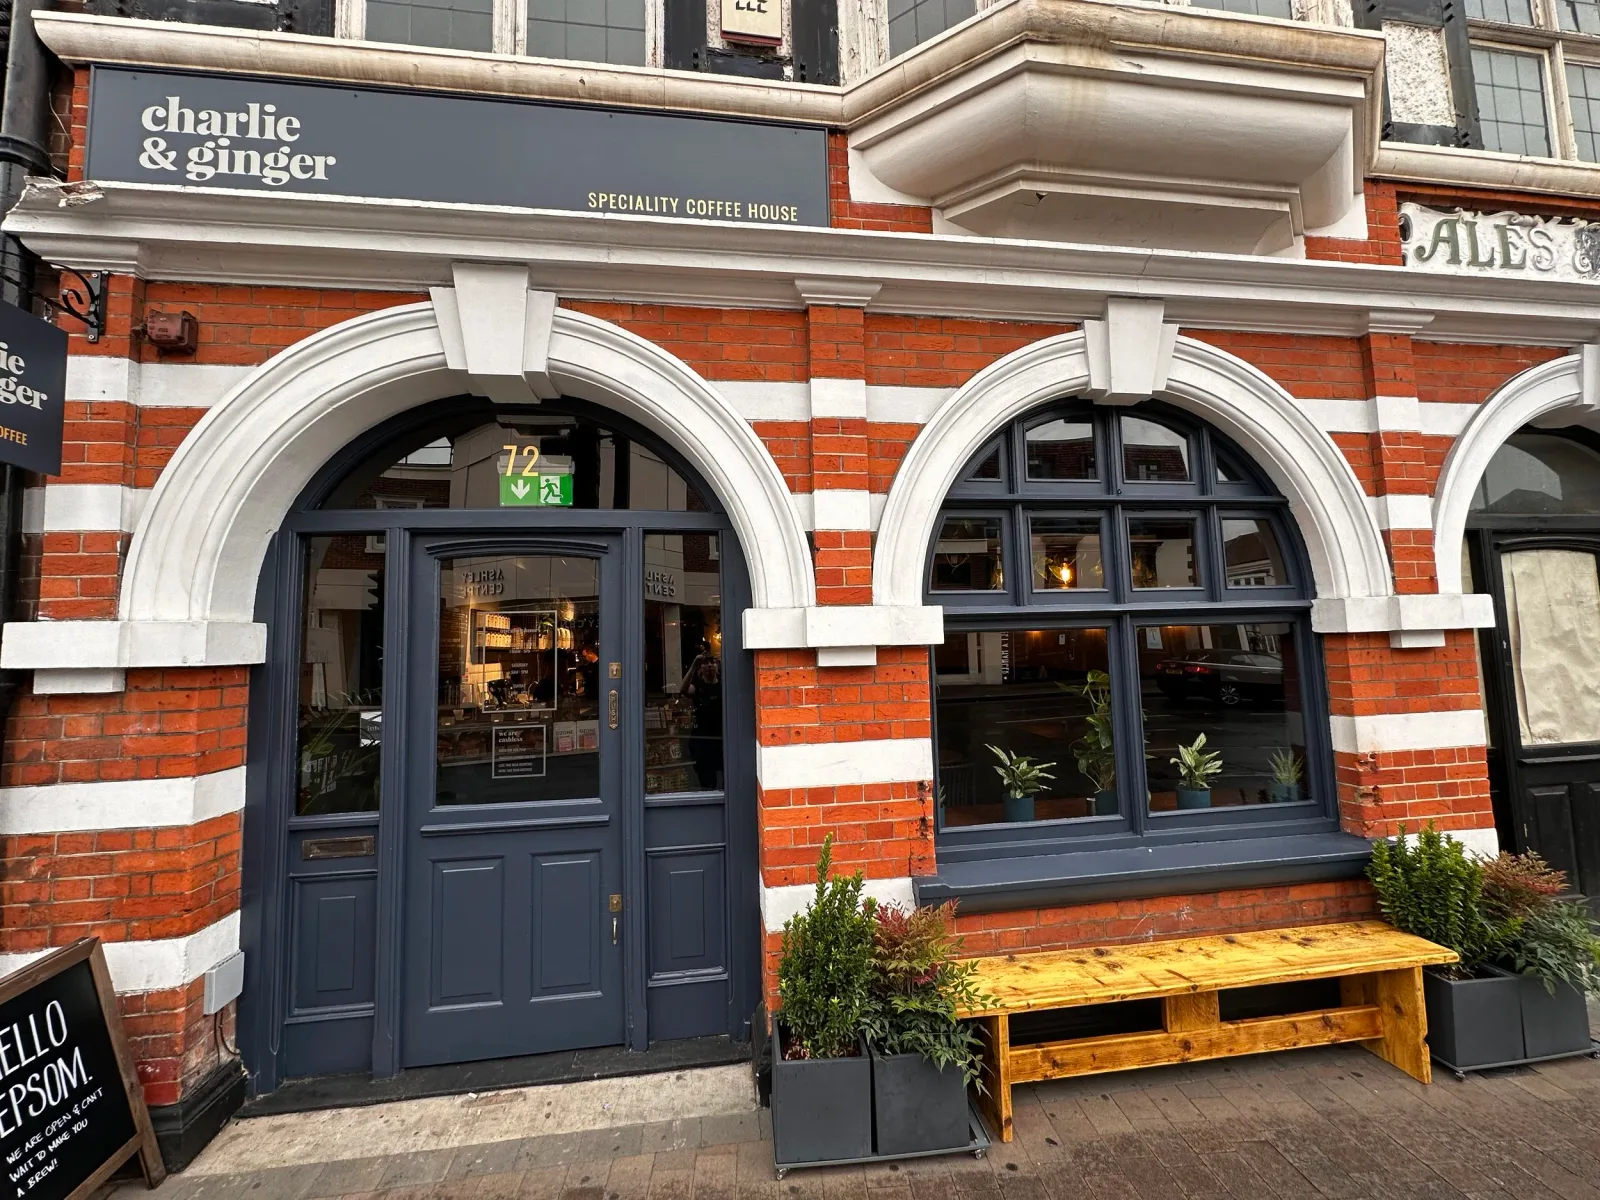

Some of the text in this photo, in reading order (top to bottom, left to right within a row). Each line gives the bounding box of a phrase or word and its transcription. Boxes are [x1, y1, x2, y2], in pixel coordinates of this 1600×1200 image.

[141, 96, 301, 142] charlie
[138, 136, 337, 186] & ginger
[588, 192, 798, 222] SPECIALITY COFFEE HOUSE
[1413, 218, 1556, 272] ALES
[503, 445, 539, 477] 72
[0, 999, 67, 1081] ELLO
[0, 1046, 93, 1138] EPSOM.
[6, 1147, 22, 1164] WE
[24, 1132, 43, 1152] ARE
[45, 1112, 72, 1136] OPEN
[72, 1103, 80, 1115] &
[8, 1118, 88, 1182] WAIT TO MAKE YOU
[16, 1158, 59, 1198] A BREW!
